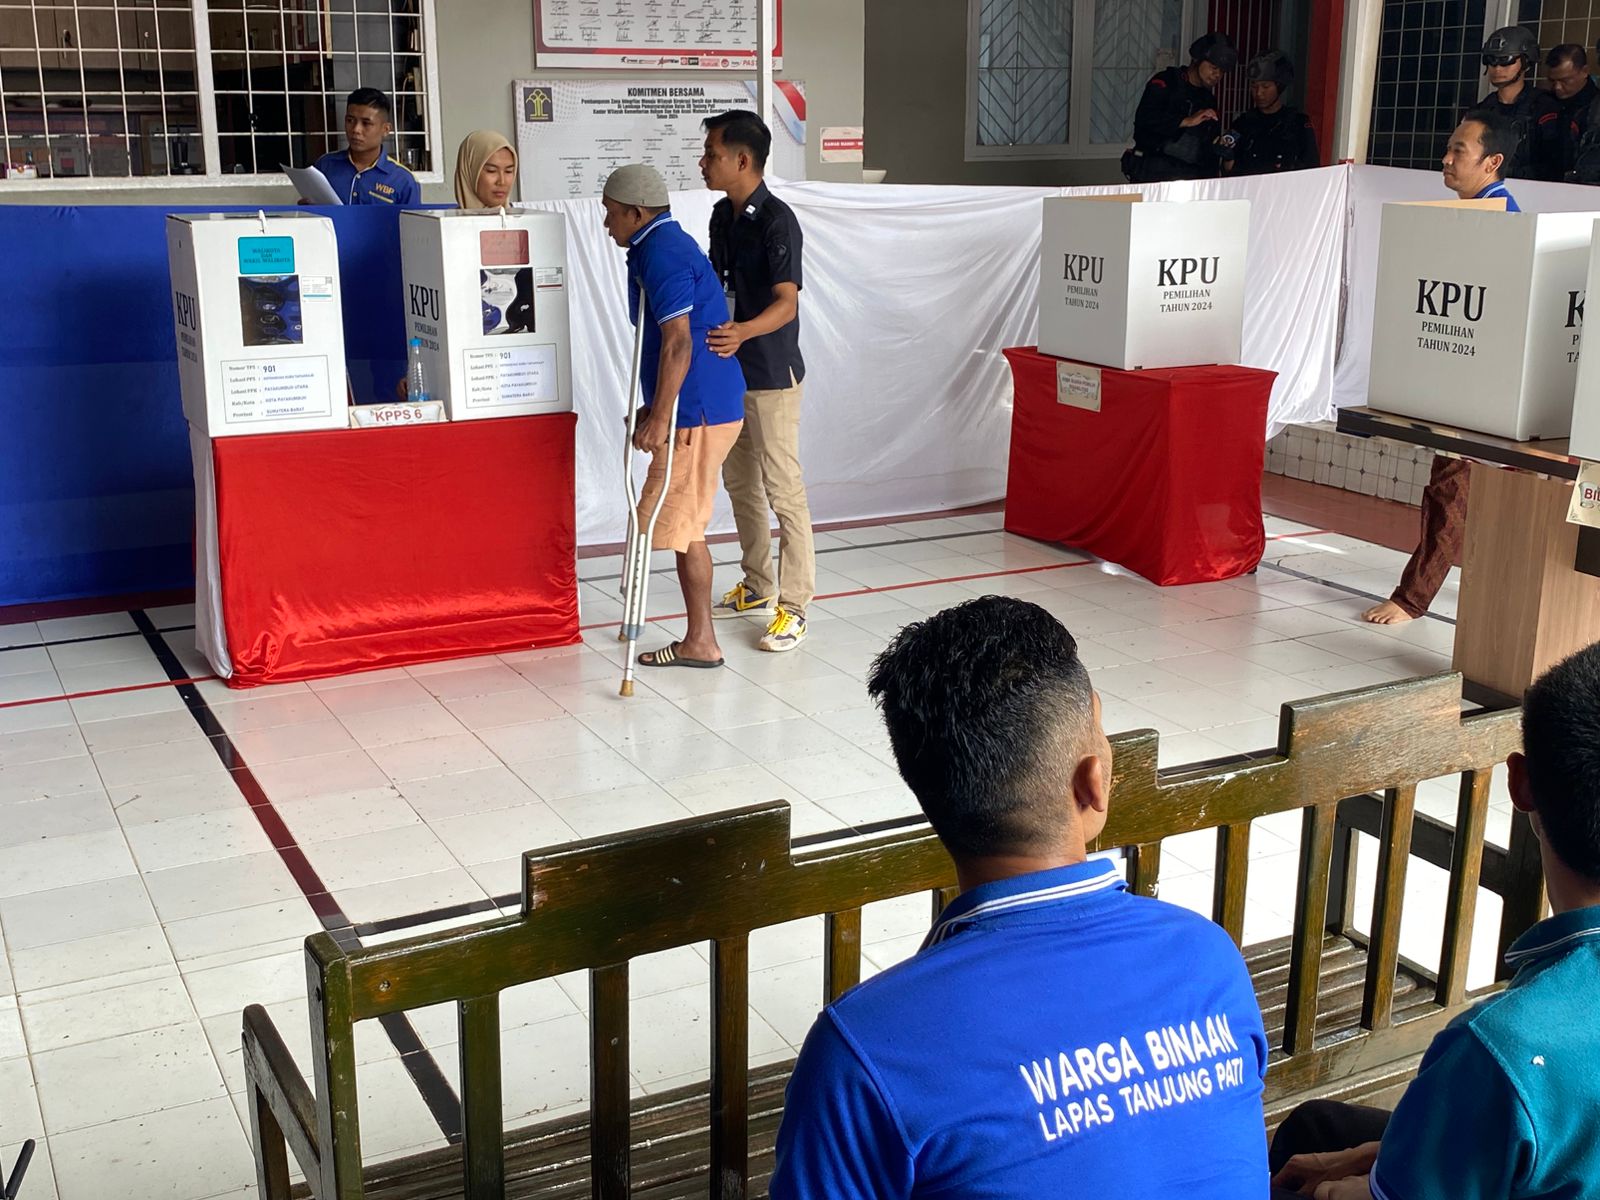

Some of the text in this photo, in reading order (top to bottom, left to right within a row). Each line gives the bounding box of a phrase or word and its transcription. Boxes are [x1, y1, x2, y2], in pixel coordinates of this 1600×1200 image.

[627, 88, 705, 97] KOMITMEN BERSAMA
[375, 182, 395, 195] WBP
[1063, 253, 1105, 284] KPU
[1157, 257, 1220, 287] KPU
[1067, 285, 1098, 297] PEMILIHAN
[1163, 289, 1211, 300] PEMILIHAN
[1416, 278, 1487, 322] KPU
[175, 291, 196, 331] KPU
[409, 284, 440, 321] KPU
[1065, 297, 1099, 310] TAHUN 2024
[1160, 301, 1213, 313] TAHUN 2024
[1421, 321, 1475, 339] PEMILIHAN
[1417, 337, 1476, 357] TAHUN 2024
[262, 365, 276, 373] 901
[375, 409, 423, 422] KPPS 6
[1019, 1013, 1238, 1105] WARGA BINAAN
[1038, 1056, 1244, 1141] LAPAS TANJUNG PATI
